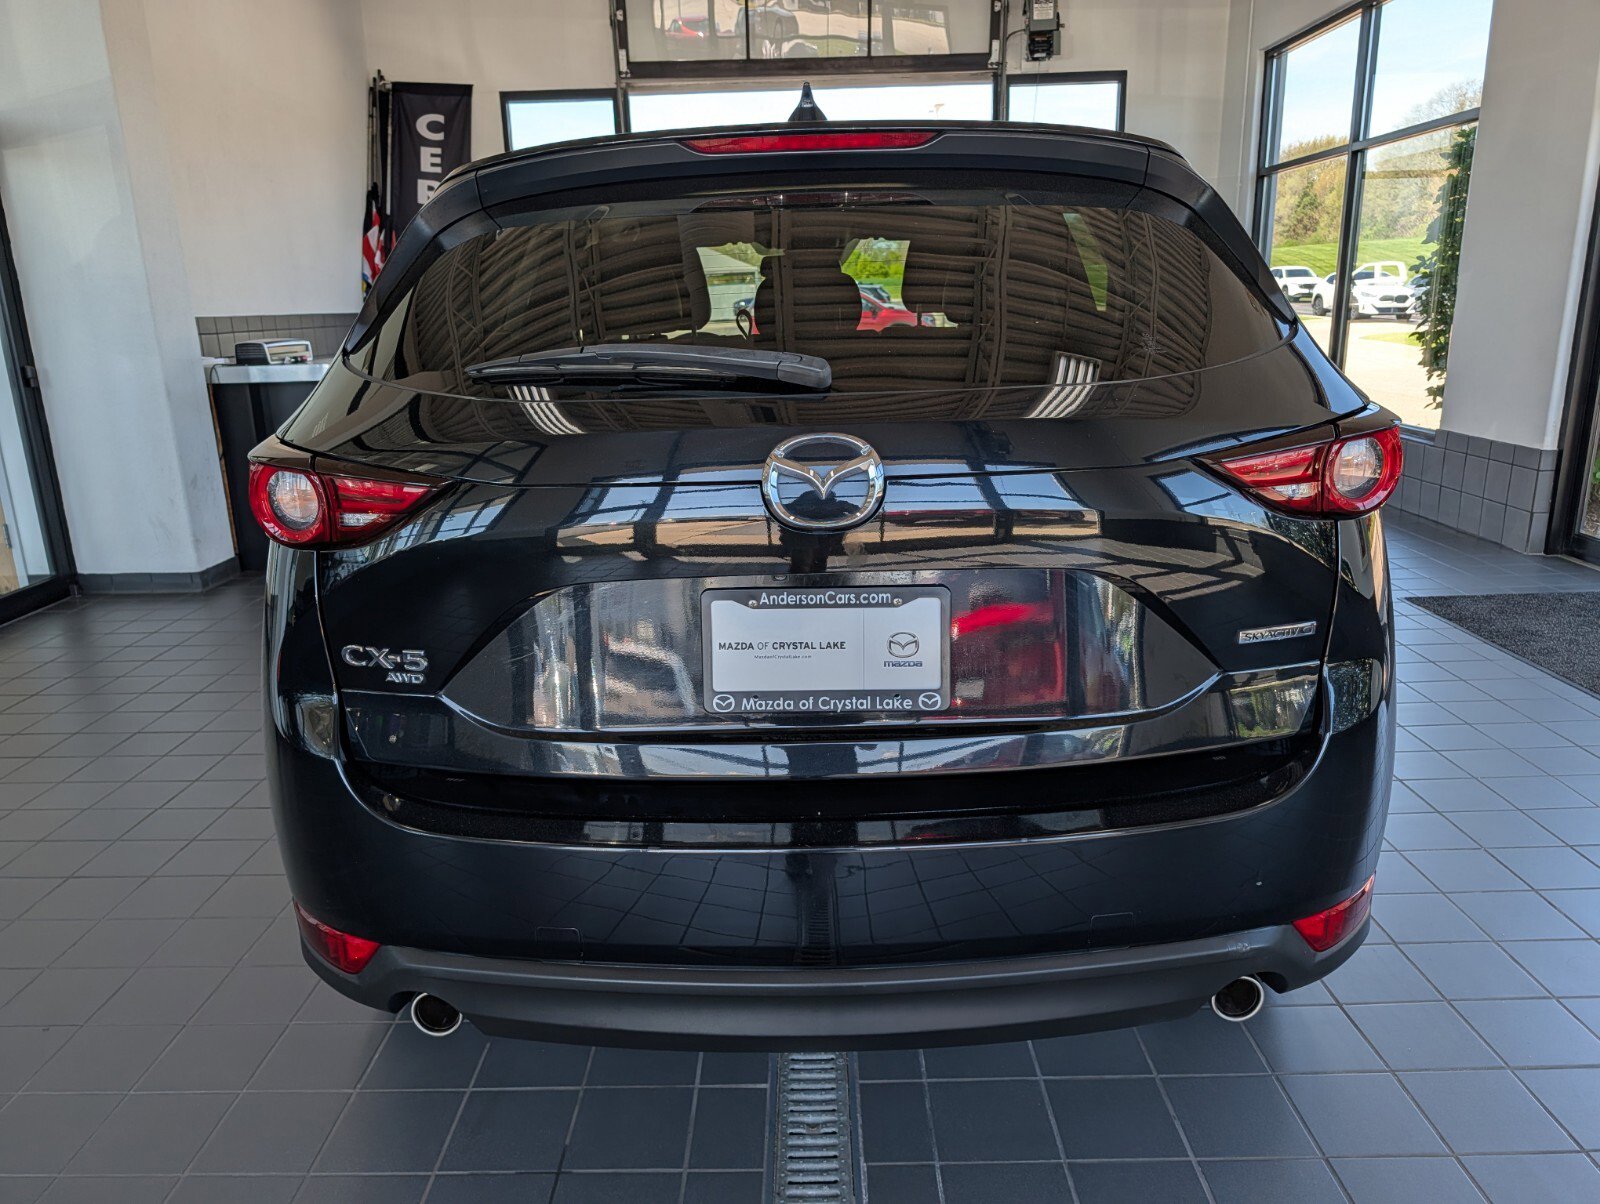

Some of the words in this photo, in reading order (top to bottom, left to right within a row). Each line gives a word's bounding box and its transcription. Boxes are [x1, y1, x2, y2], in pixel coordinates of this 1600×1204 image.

[759, 591, 892, 605] AndersonCars.com
[718, 641, 754, 651] MAZDA
[757, 641, 770, 650] OF
[772, 641, 817, 650] CRYSTAL
[819, 641, 846, 650] LAKE
[341, 644, 428, 672] CX-5
[883, 660, 923, 668] mazda
[385, 671, 424, 684] AWD
[741, 697, 794, 711] Mazda
[798, 696, 813, 710] of
[818, 696, 873, 713] Crystal
[876, 695, 913, 709] Lake
